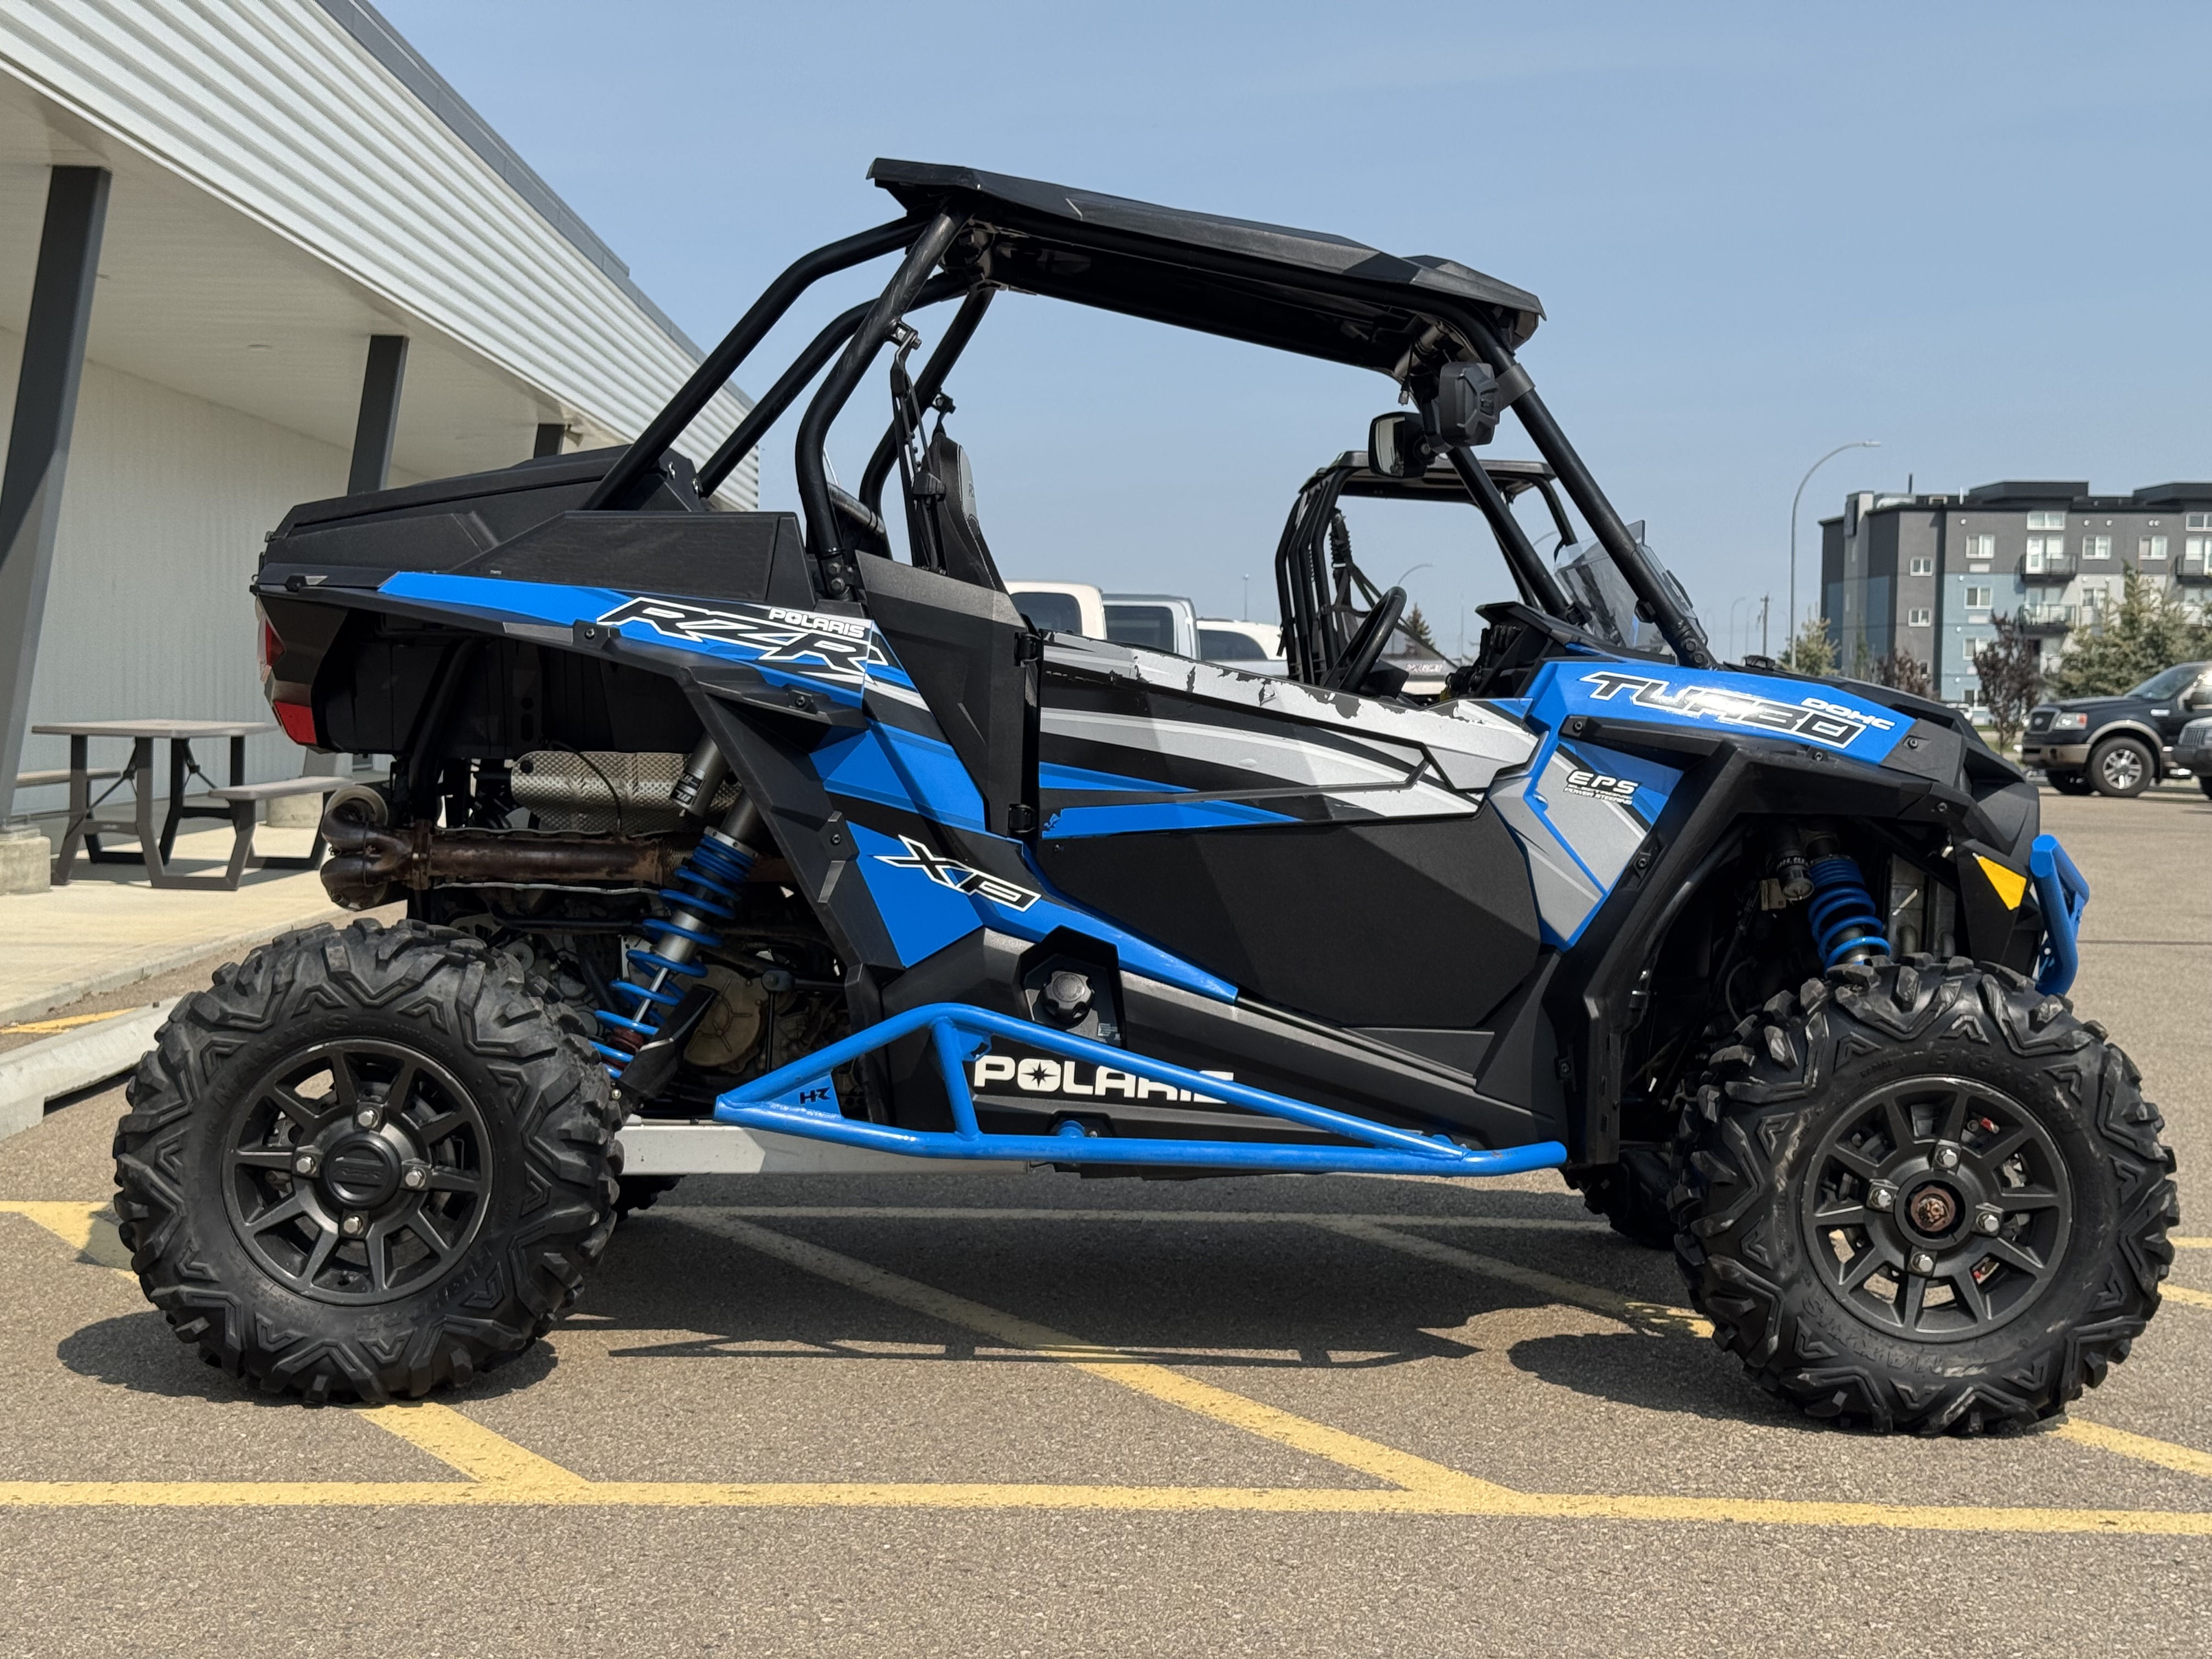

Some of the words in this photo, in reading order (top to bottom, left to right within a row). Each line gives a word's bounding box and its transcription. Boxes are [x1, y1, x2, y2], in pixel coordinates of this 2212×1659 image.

[596, 596, 889, 684] RZR
[768, 608, 866, 638] POLARIS
[1579, 670, 1866, 749] TURBO
[1801, 697, 1895, 731] DOHC
[1568, 770, 1639, 794] EPS
[873, 834, 1041, 912] XP
